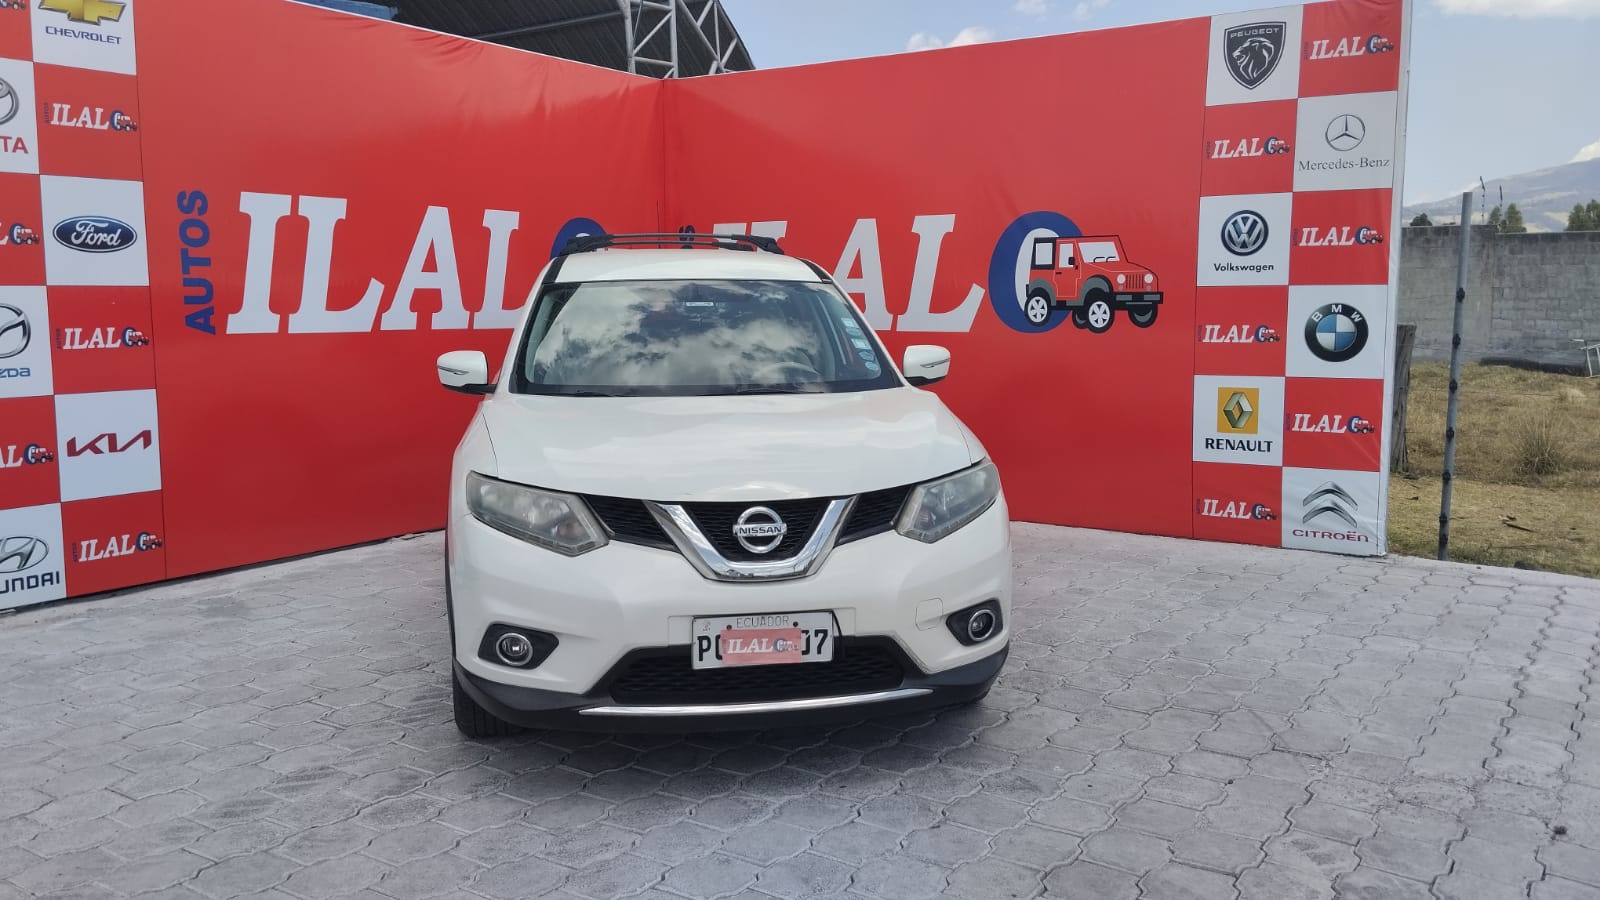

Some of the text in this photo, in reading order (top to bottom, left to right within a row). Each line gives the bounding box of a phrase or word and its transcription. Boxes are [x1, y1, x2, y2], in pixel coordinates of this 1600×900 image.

[45, 25, 122, 45] CHEVROLET
[1230, 27, 1281, 39] PEUGEOT
[1298, 157, 1390, 172] Mercedes-Benz
[71, 220, 122, 246] Ford
[176, 189, 606, 335] AUTOS ILAL
[1213, 262, 1275, 273] Volkswagen
[1311, 304, 1363, 323] BMW
[1205, 437, 1273, 453] RENAULT
[738, 526, 782, 535] NISSAN
[0, 570, 60, 594] UNDAI
[736, 615, 790, 629] ECUADOR
